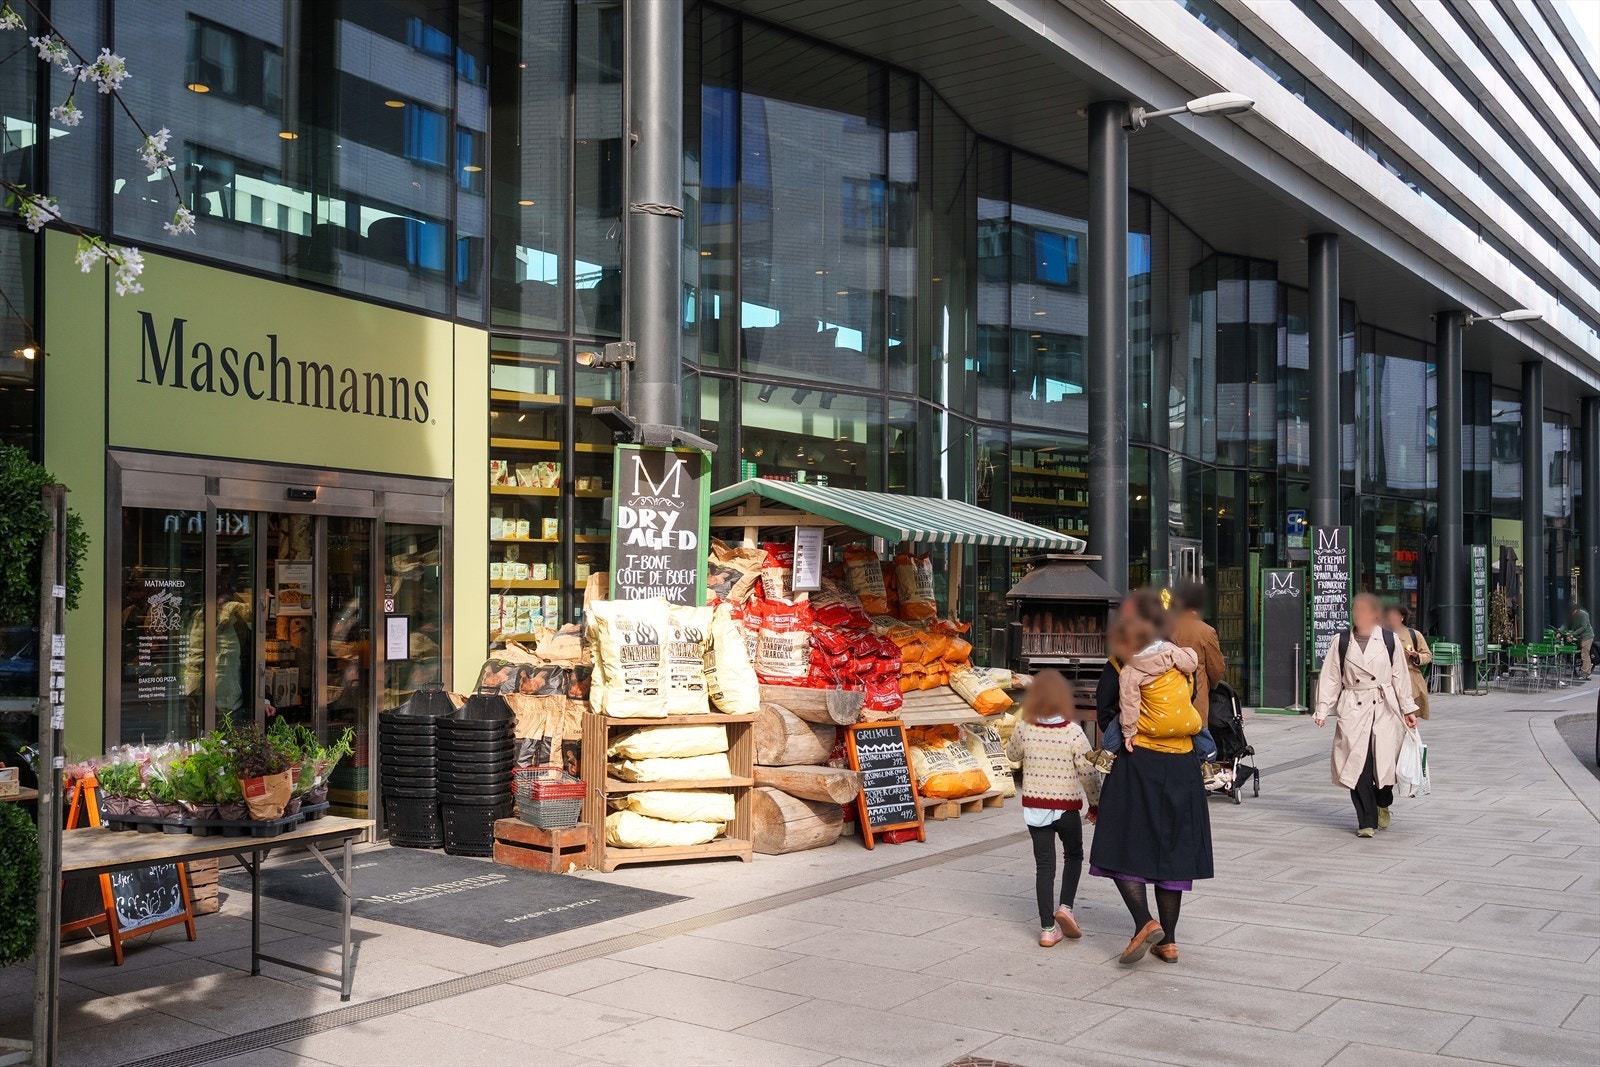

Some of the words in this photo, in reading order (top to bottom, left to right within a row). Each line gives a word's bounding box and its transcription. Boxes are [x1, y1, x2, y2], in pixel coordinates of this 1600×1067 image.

[137, 311, 429, 424] Maschmanns
[632, 455, 687, 498] M
[617, 506, 680, 532] DRY
[623, 528, 698, 550] AGED
[1318, 529, 1340, 549] M
[626, 555, 672, 570] T-BONE
[144, 580, 185, 588] MATMARKED
[617, 566, 647, 585] CÔTE
[650, 570, 663, 585] DE
[666, 569, 698, 585] BOEUF
[1271, 572, 1295, 589] M
[622, 586, 688, 601] TOMAHAWK
[868, 805, 902, 816] AMAZULU
